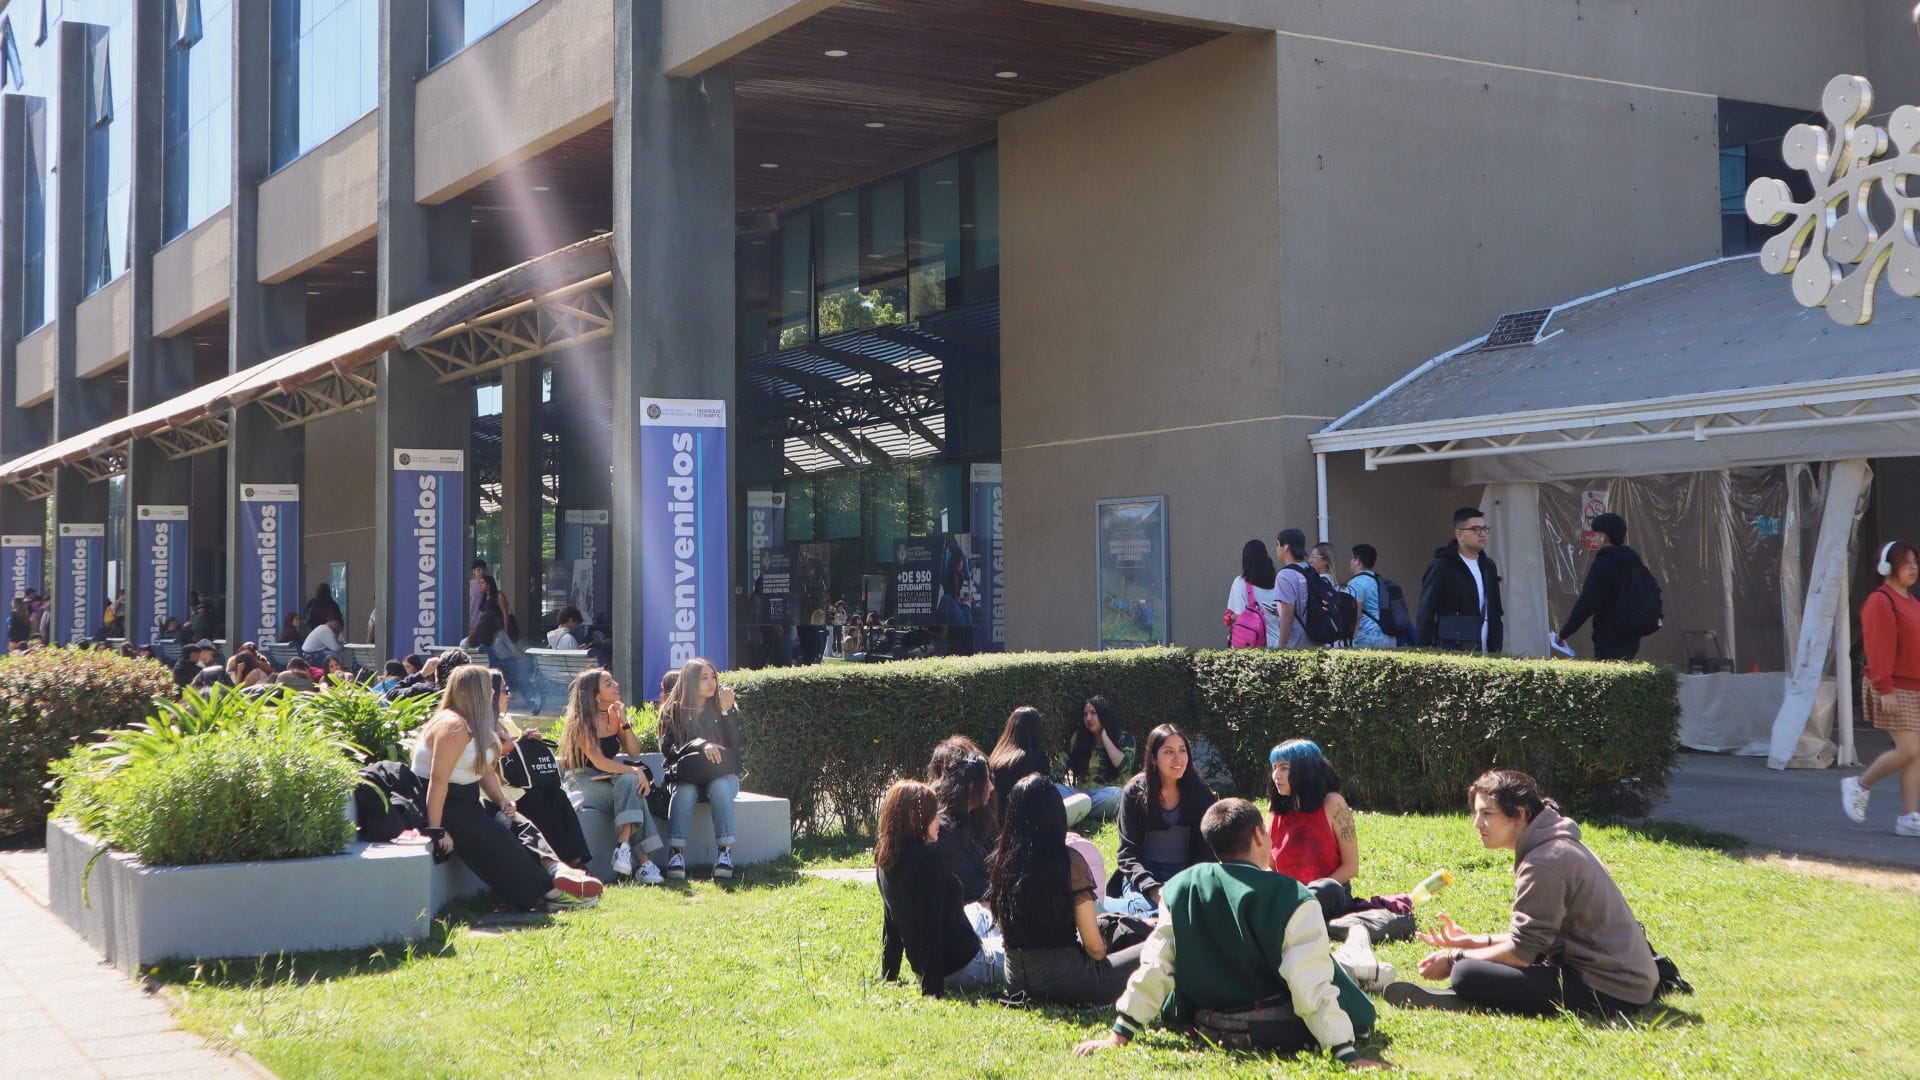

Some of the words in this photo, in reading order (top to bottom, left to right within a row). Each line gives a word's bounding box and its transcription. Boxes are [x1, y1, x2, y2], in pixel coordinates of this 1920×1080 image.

[413, 475, 436, 655] Bienvenidos
[667, 432, 696, 669] Bienvenidos
[897, 583, 932, 591] ESTUDIANTES
[915, 570, 932, 583] 950
